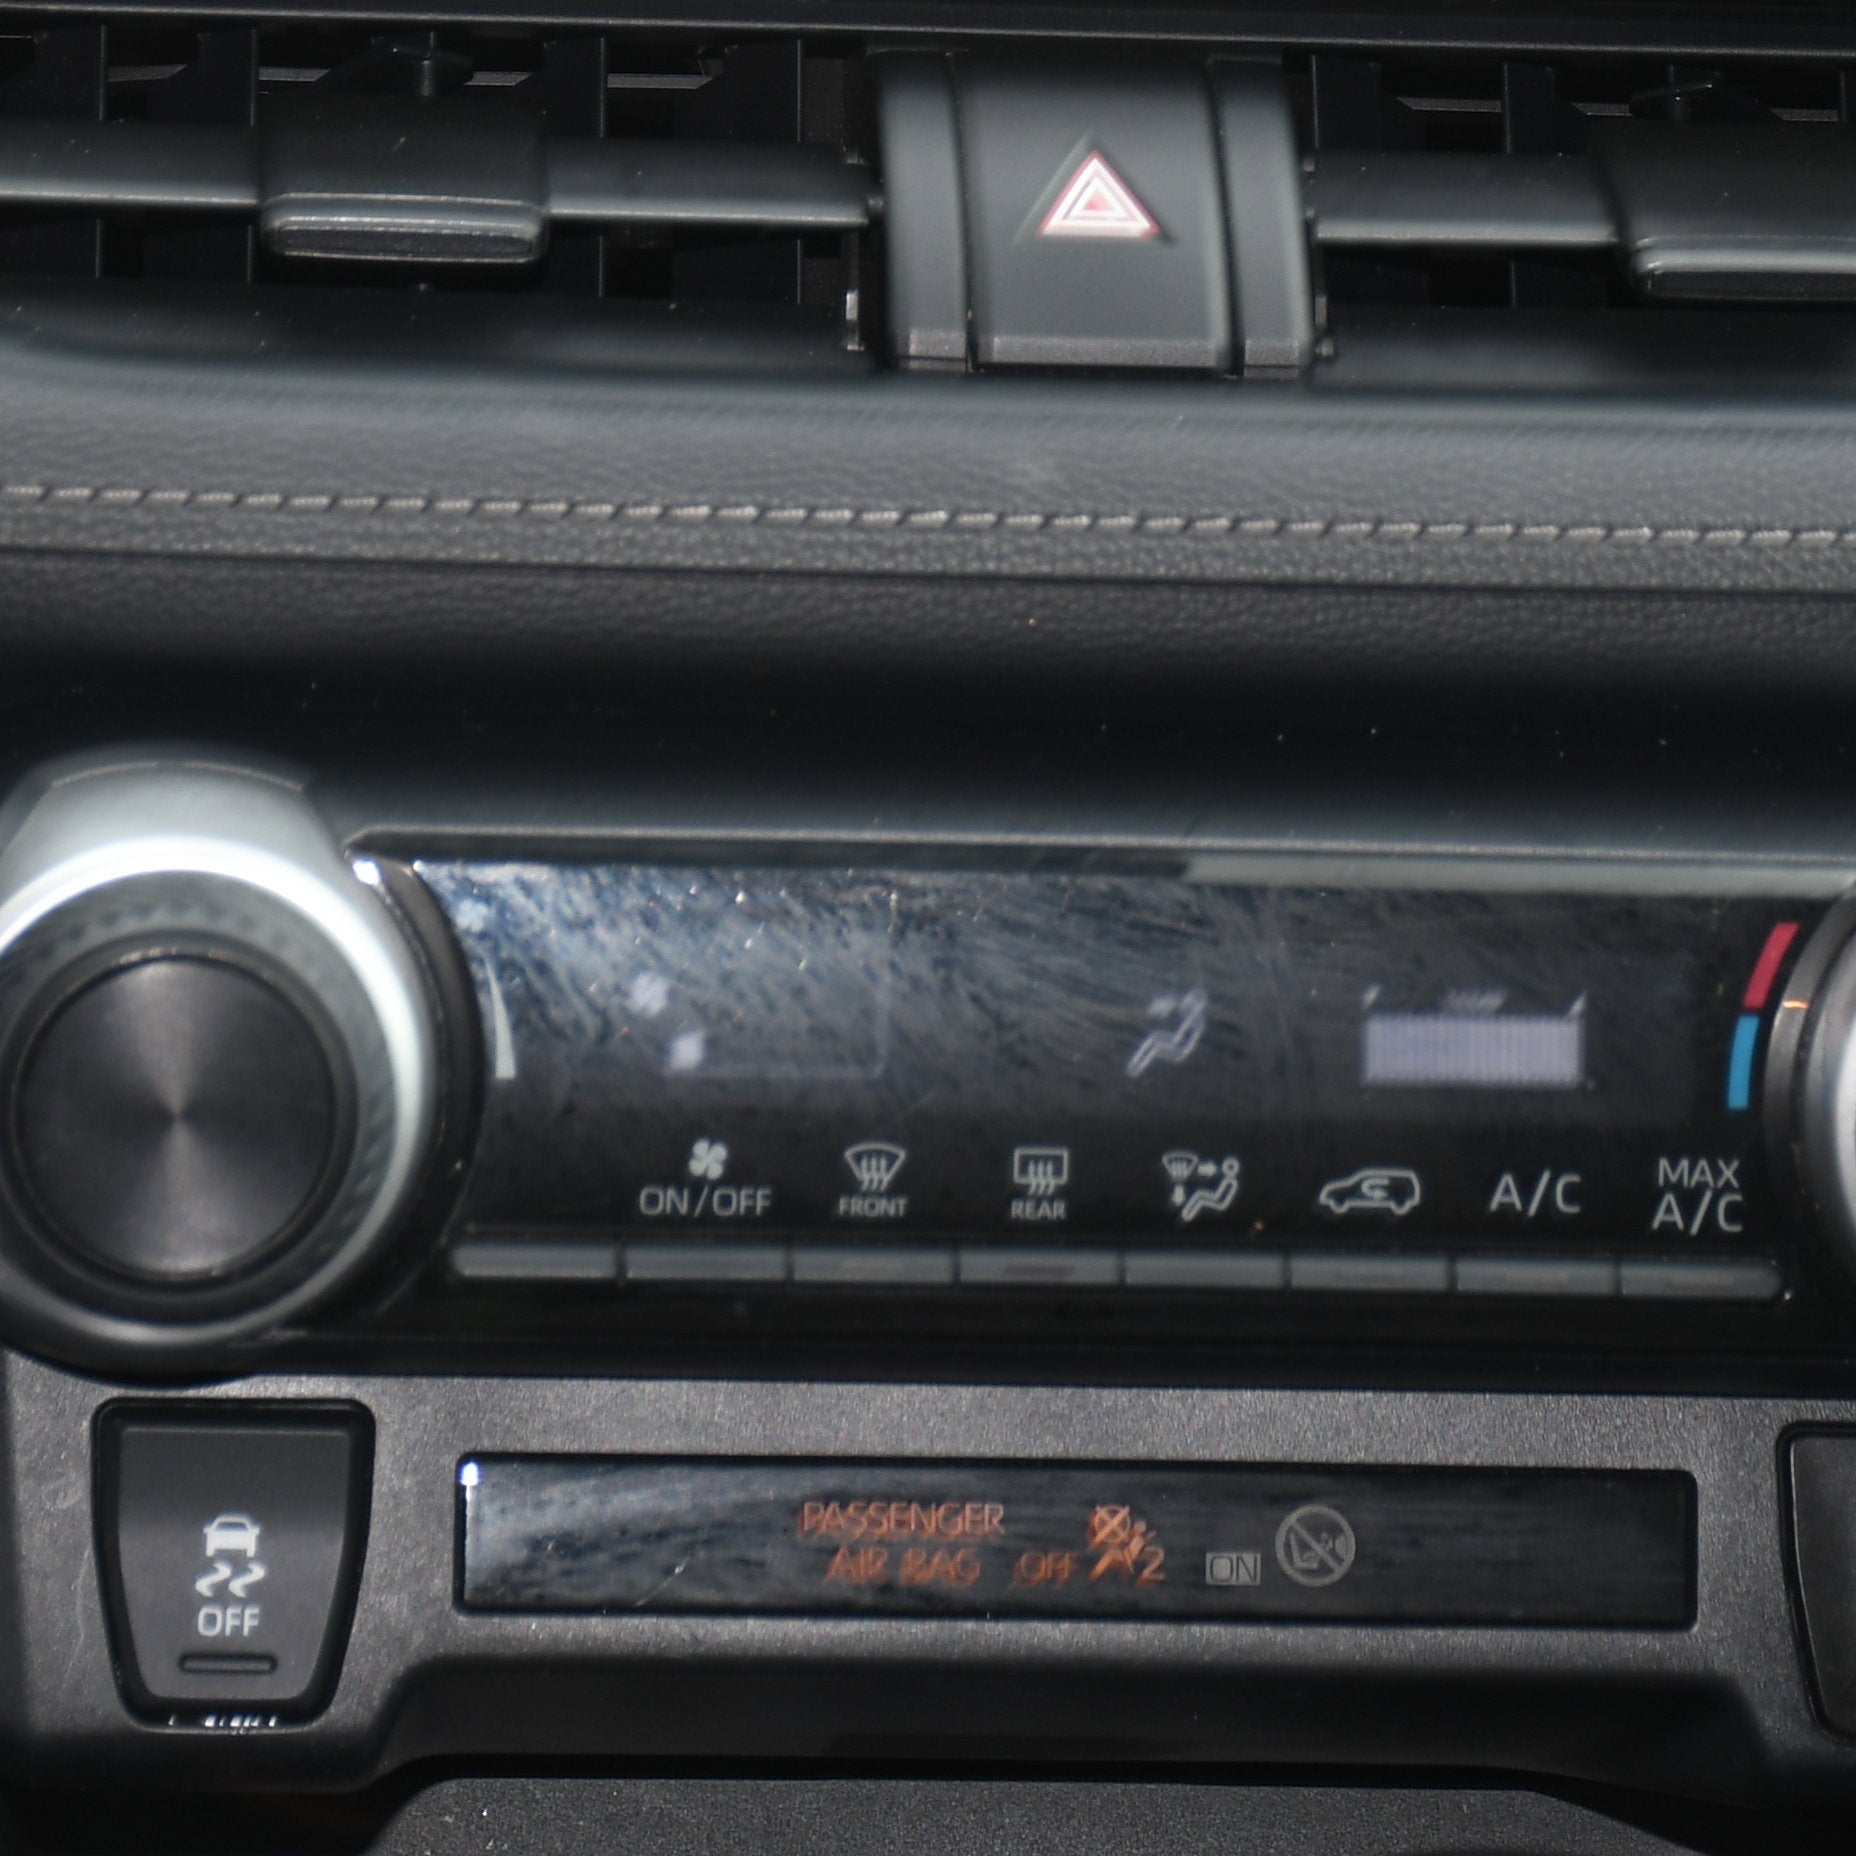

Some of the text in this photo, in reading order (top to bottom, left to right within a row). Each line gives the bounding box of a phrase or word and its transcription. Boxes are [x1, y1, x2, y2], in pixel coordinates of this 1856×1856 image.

[1656, 1157, 1740, 1189] MAX
[637, 1185, 773, 1220] ON/OFF
[837, 1193, 909, 1221] FRONT
[1009, 1195, 1068, 1223] REAR
[1489, 1169, 1582, 1217] A/C
[1650, 1191, 1745, 1236] A/C
[798, 1500, 1006, 1537] PASSENGER
[822, 1546, 1076, 1587] AIR BAG OFF
[1207, 1553, 1261, 1585] ON
[197, 1605, 261, 1638] OFF
